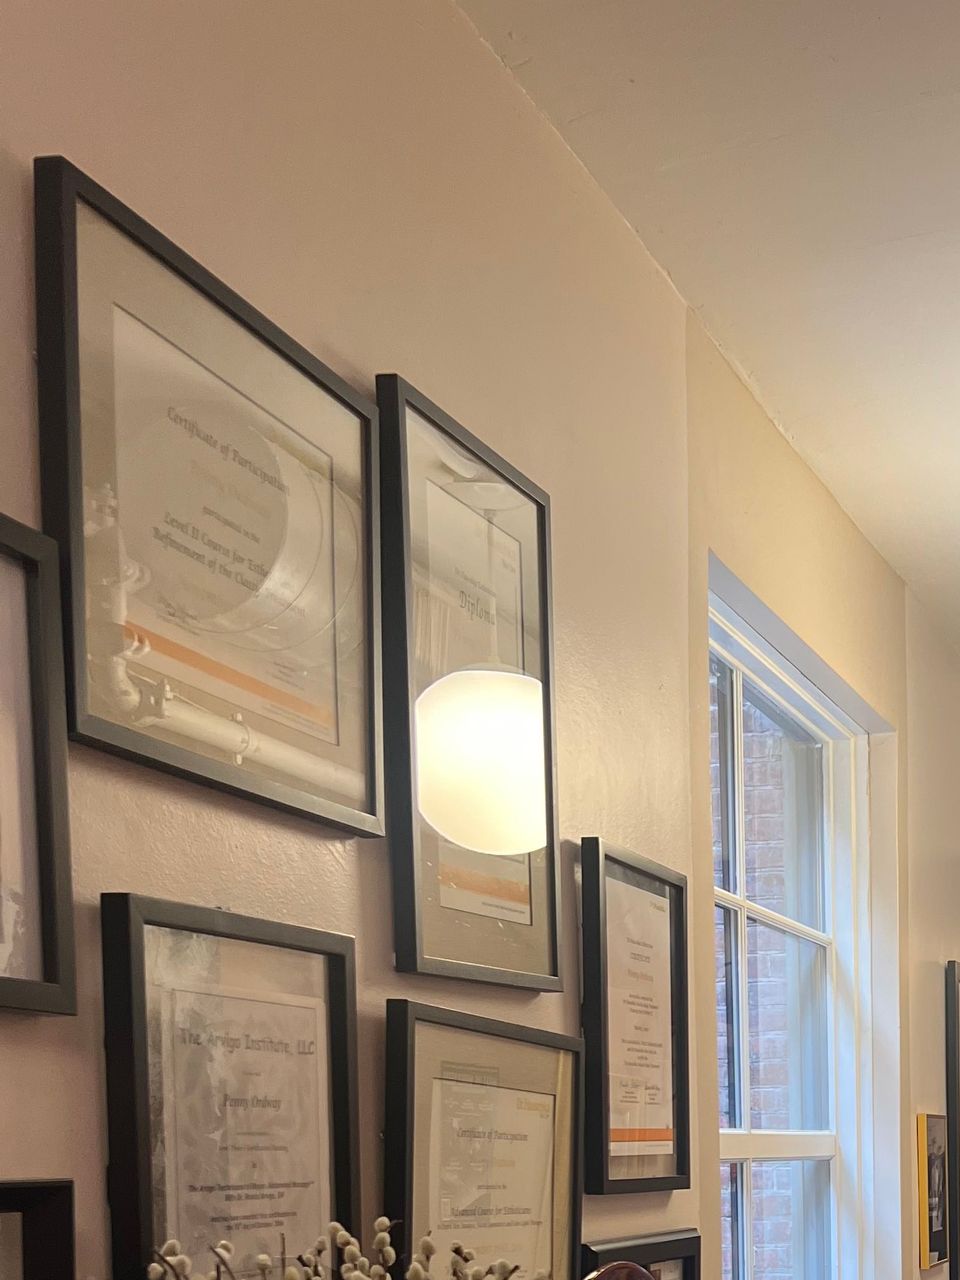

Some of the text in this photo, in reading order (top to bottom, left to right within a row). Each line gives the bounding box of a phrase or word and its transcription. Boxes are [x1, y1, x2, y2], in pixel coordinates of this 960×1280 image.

[167, 406, 218, 449] Certificate
[220, 443, 232, 461] of
[163, 511, 189, 535] Level
[178, 1026, 202, 1047] The
[297, 1040, 315, 1056] LLC
